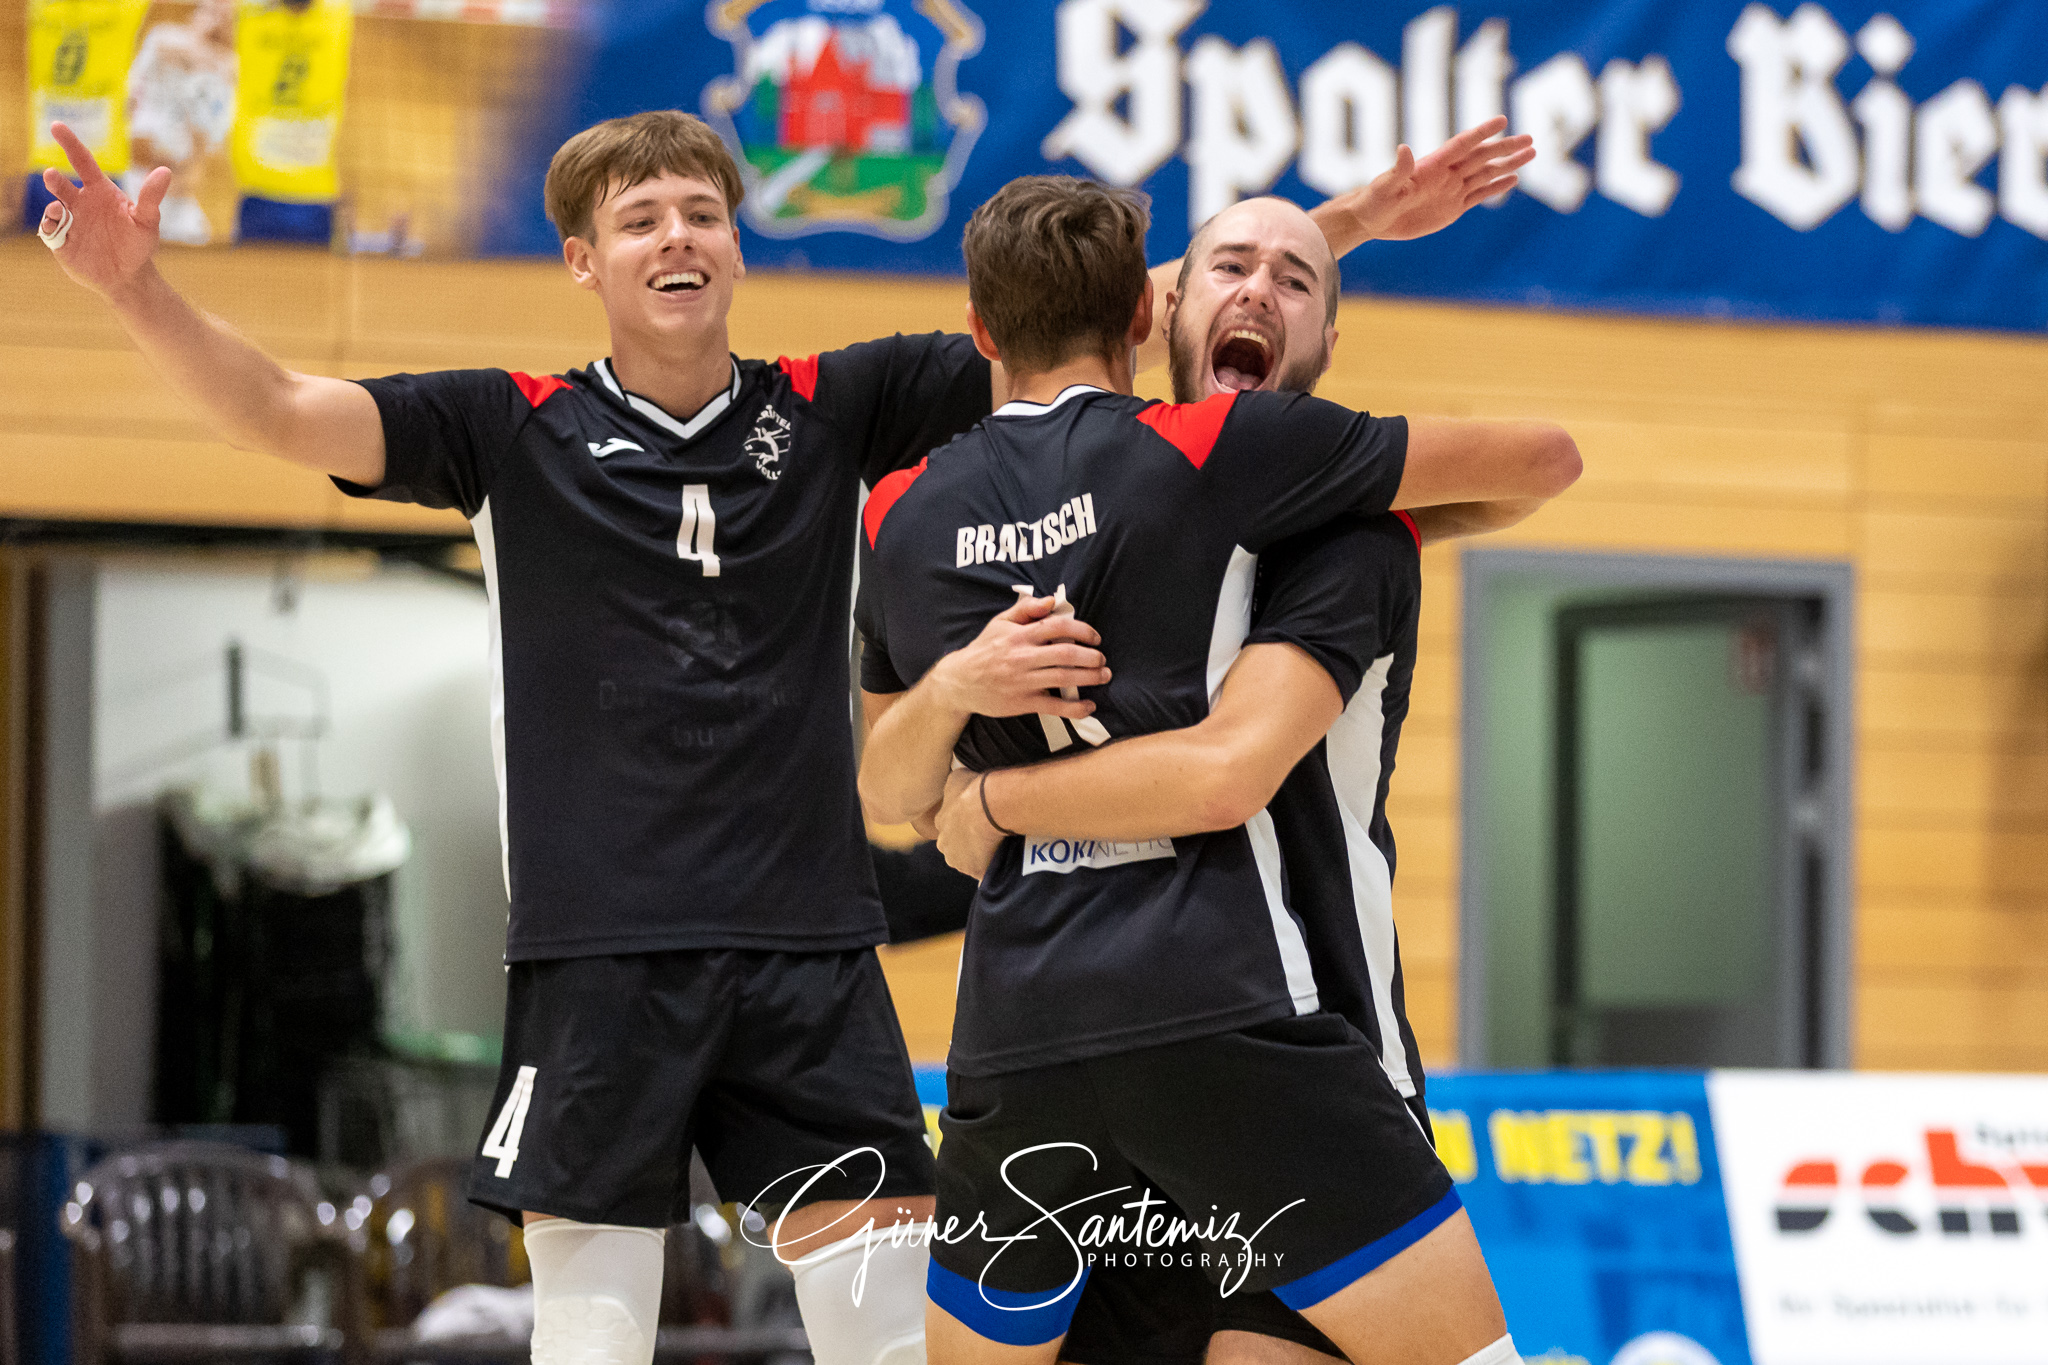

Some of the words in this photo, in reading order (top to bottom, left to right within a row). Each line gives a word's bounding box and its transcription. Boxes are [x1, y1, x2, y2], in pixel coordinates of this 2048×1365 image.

[1727, 3, 2048, 241] Bier
[756, 460, 781, 480] VOLL
[677, 485, 720, 576] 4
[482, 1065, 537, 1178] 4
[1488, 1109, 1701, 1186] NETZ!
[1771, 1126, 2048, 1238] sch
